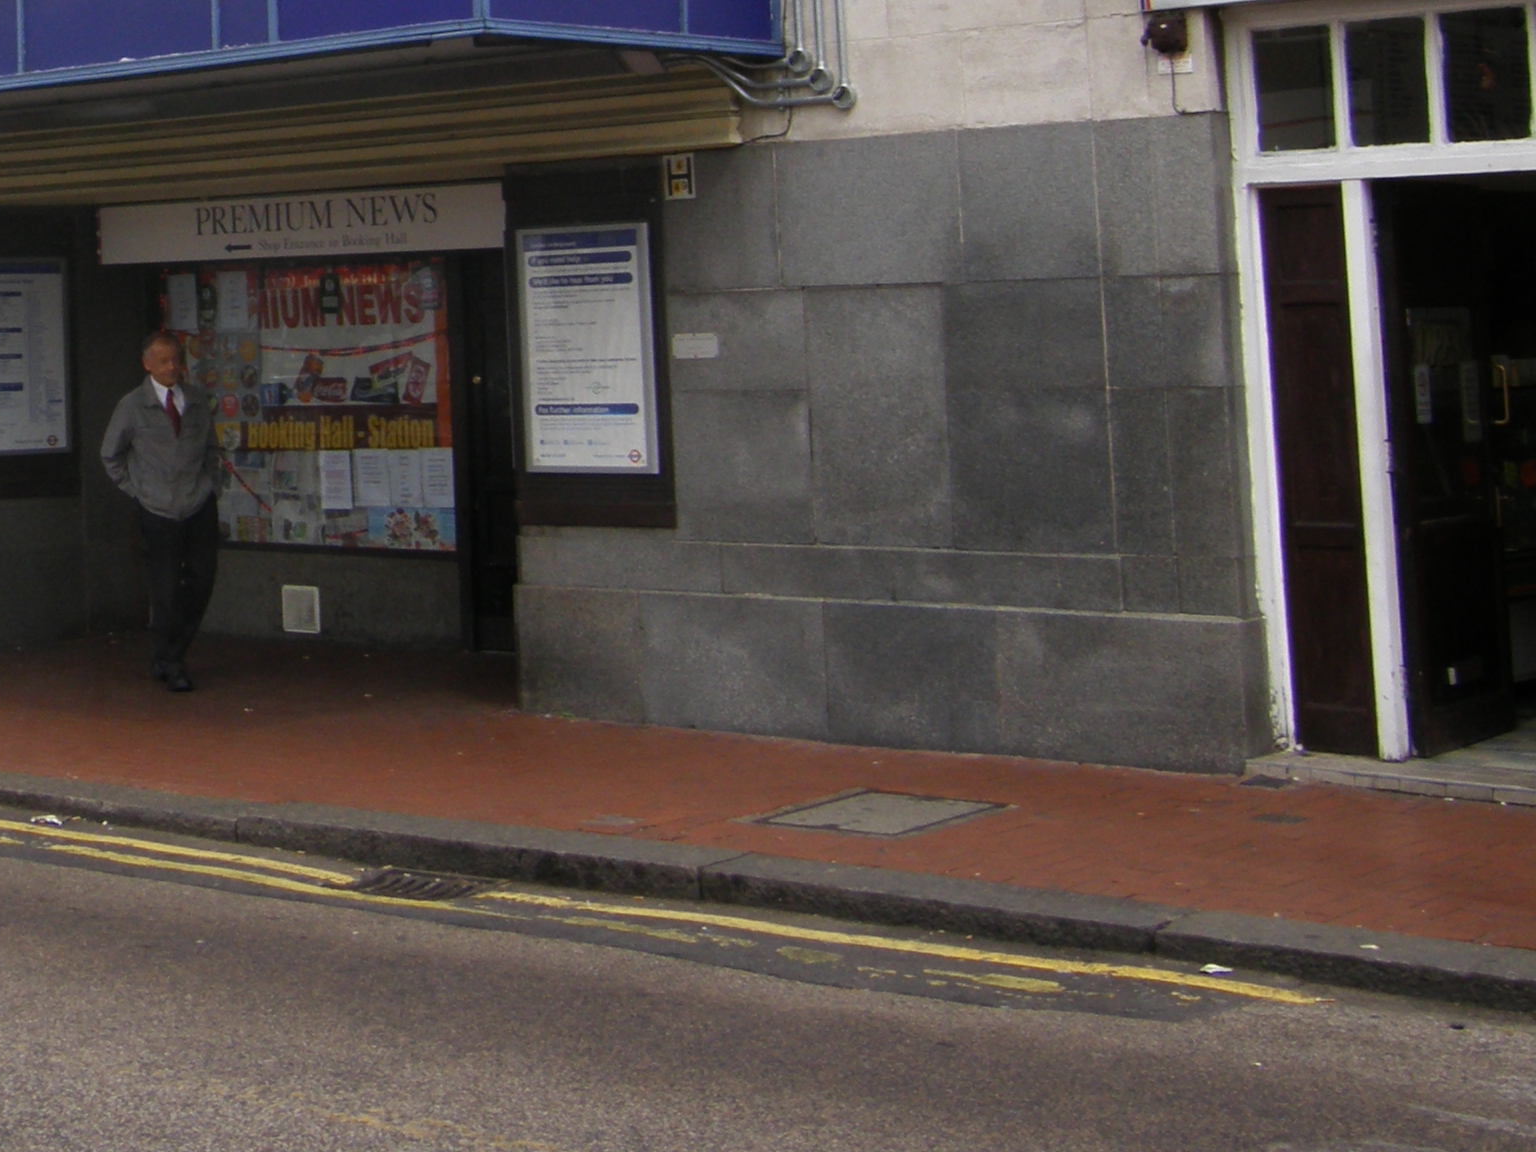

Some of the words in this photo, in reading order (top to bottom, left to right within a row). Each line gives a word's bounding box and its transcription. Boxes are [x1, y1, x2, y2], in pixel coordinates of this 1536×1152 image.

[195, 198, 333, 236] PREMIUM
[344, 192, 438, 227] NEWS
[258, 239, 280, 252] Shop
[283, 237, 325, 250] Entrance
[328, 238, 339, 248] in
[342, 234, 381, 247] Booking
[385, 232, 408, 244] Hall
[333, 280, 425, 328] NEWS
[247, 416, 315, 449] Booking
[320, 414, 354, 449] Hall
[367, 413, 435, 449] Station
